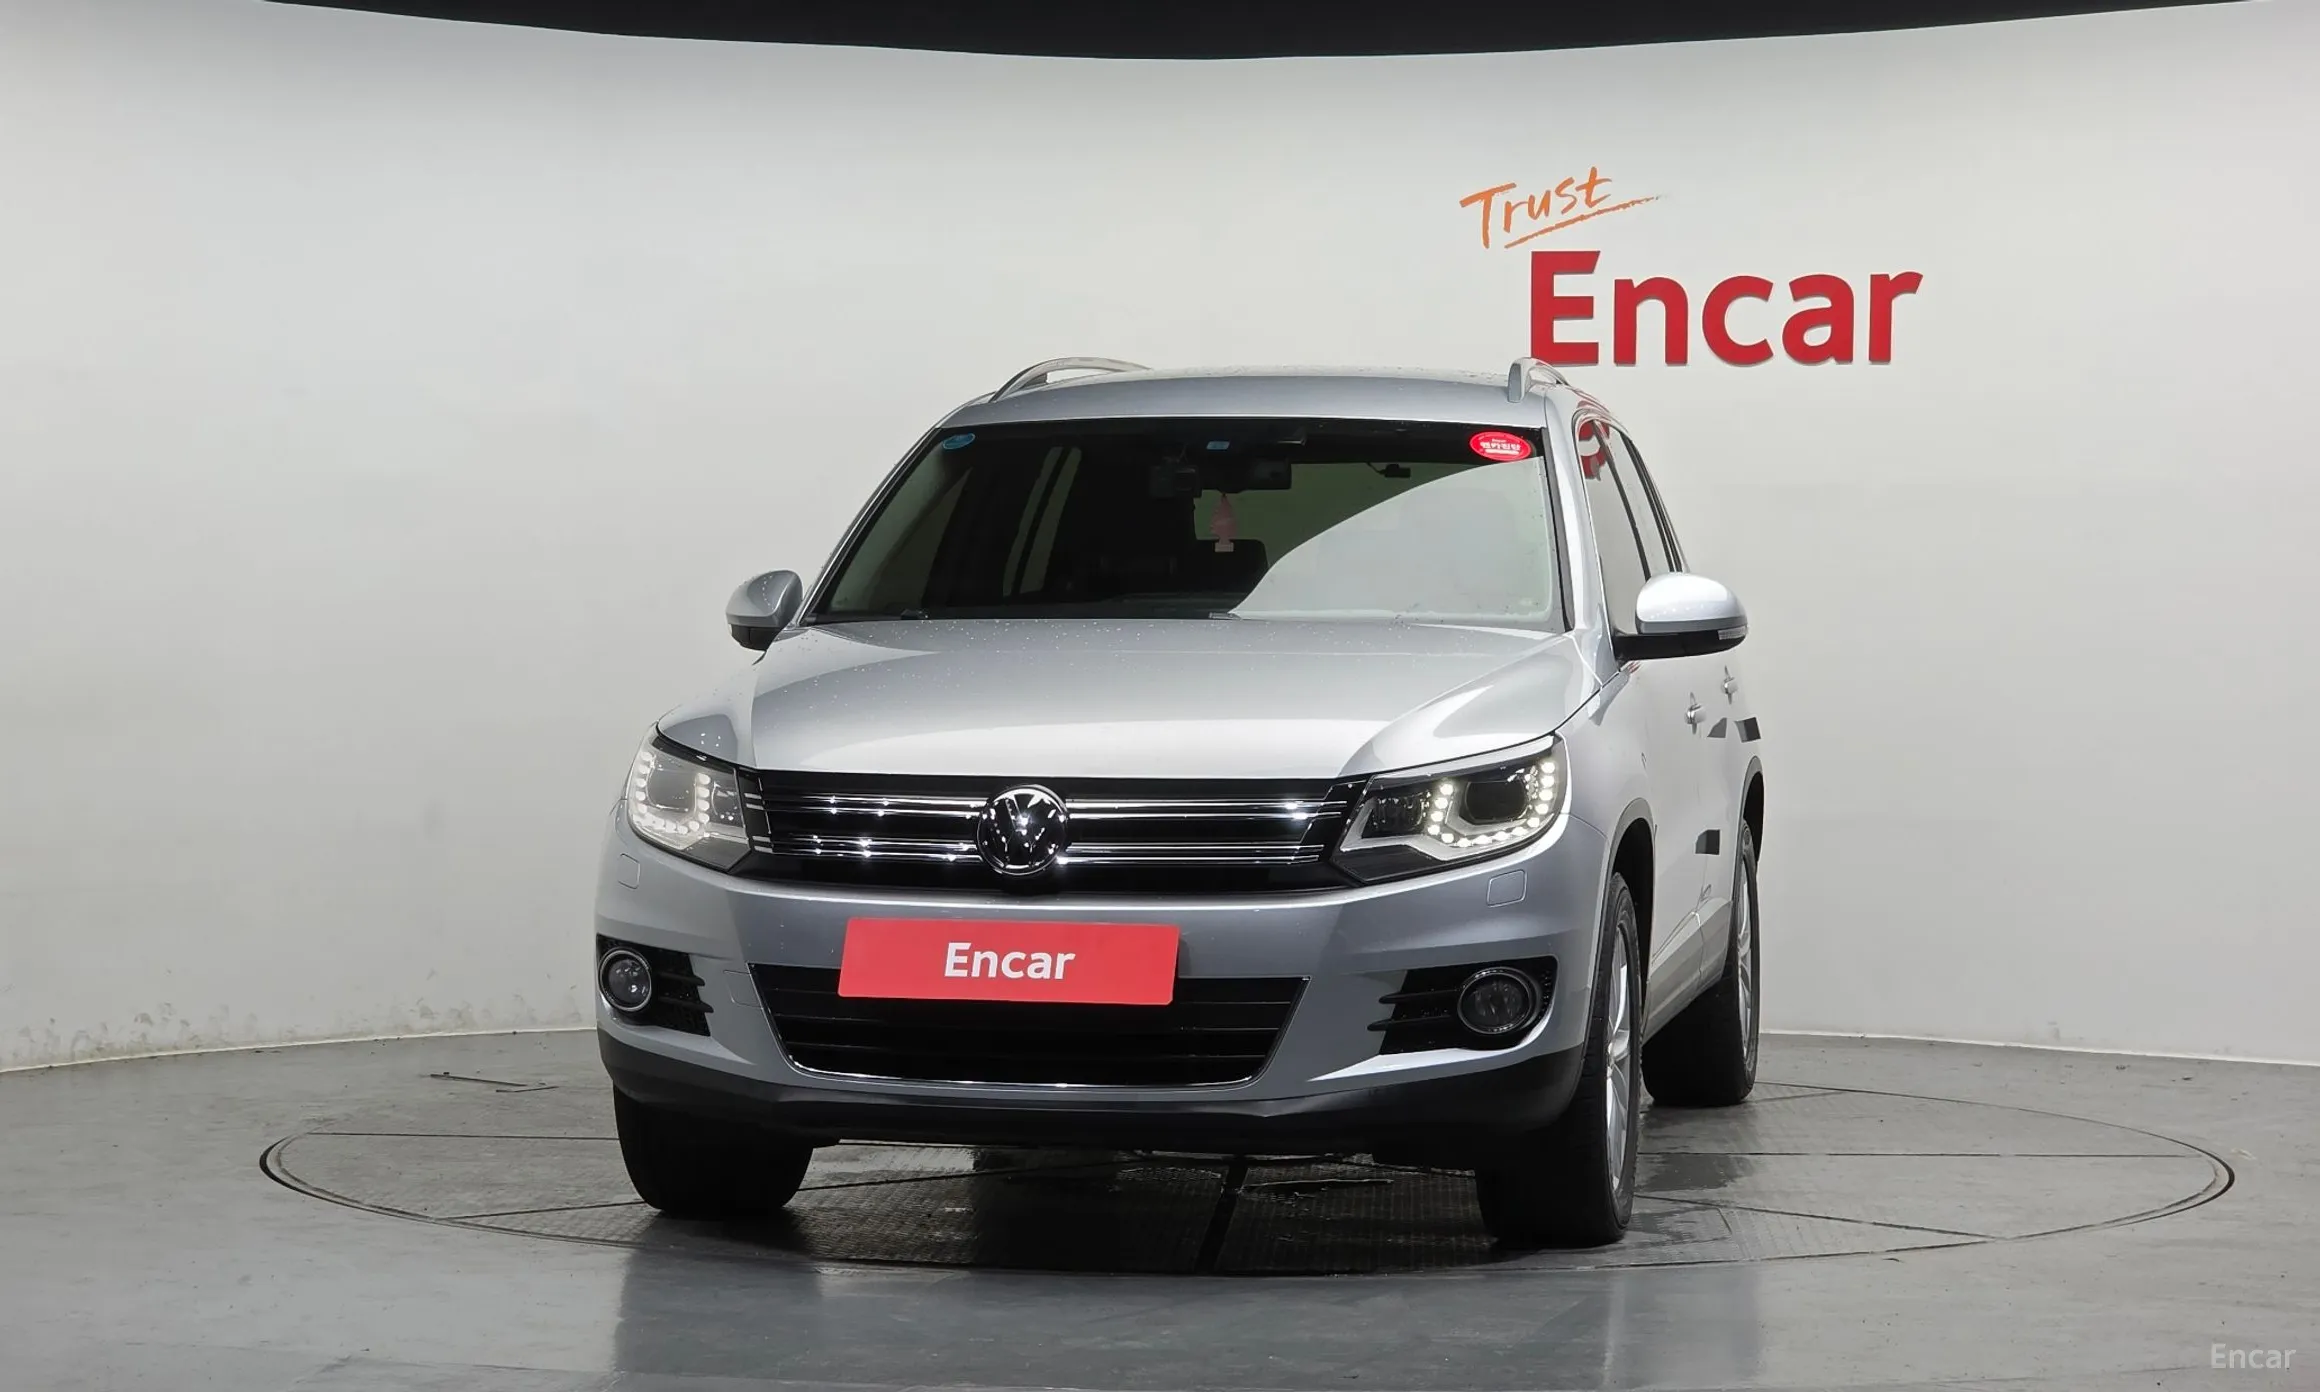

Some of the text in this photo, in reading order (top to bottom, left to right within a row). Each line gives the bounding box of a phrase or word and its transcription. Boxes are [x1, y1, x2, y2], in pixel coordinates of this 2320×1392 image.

[1459, 166, 1613, 249] Trust
[1531, 250, 1924, 366] Encar
[944, 942, 1076, 980] Encar
